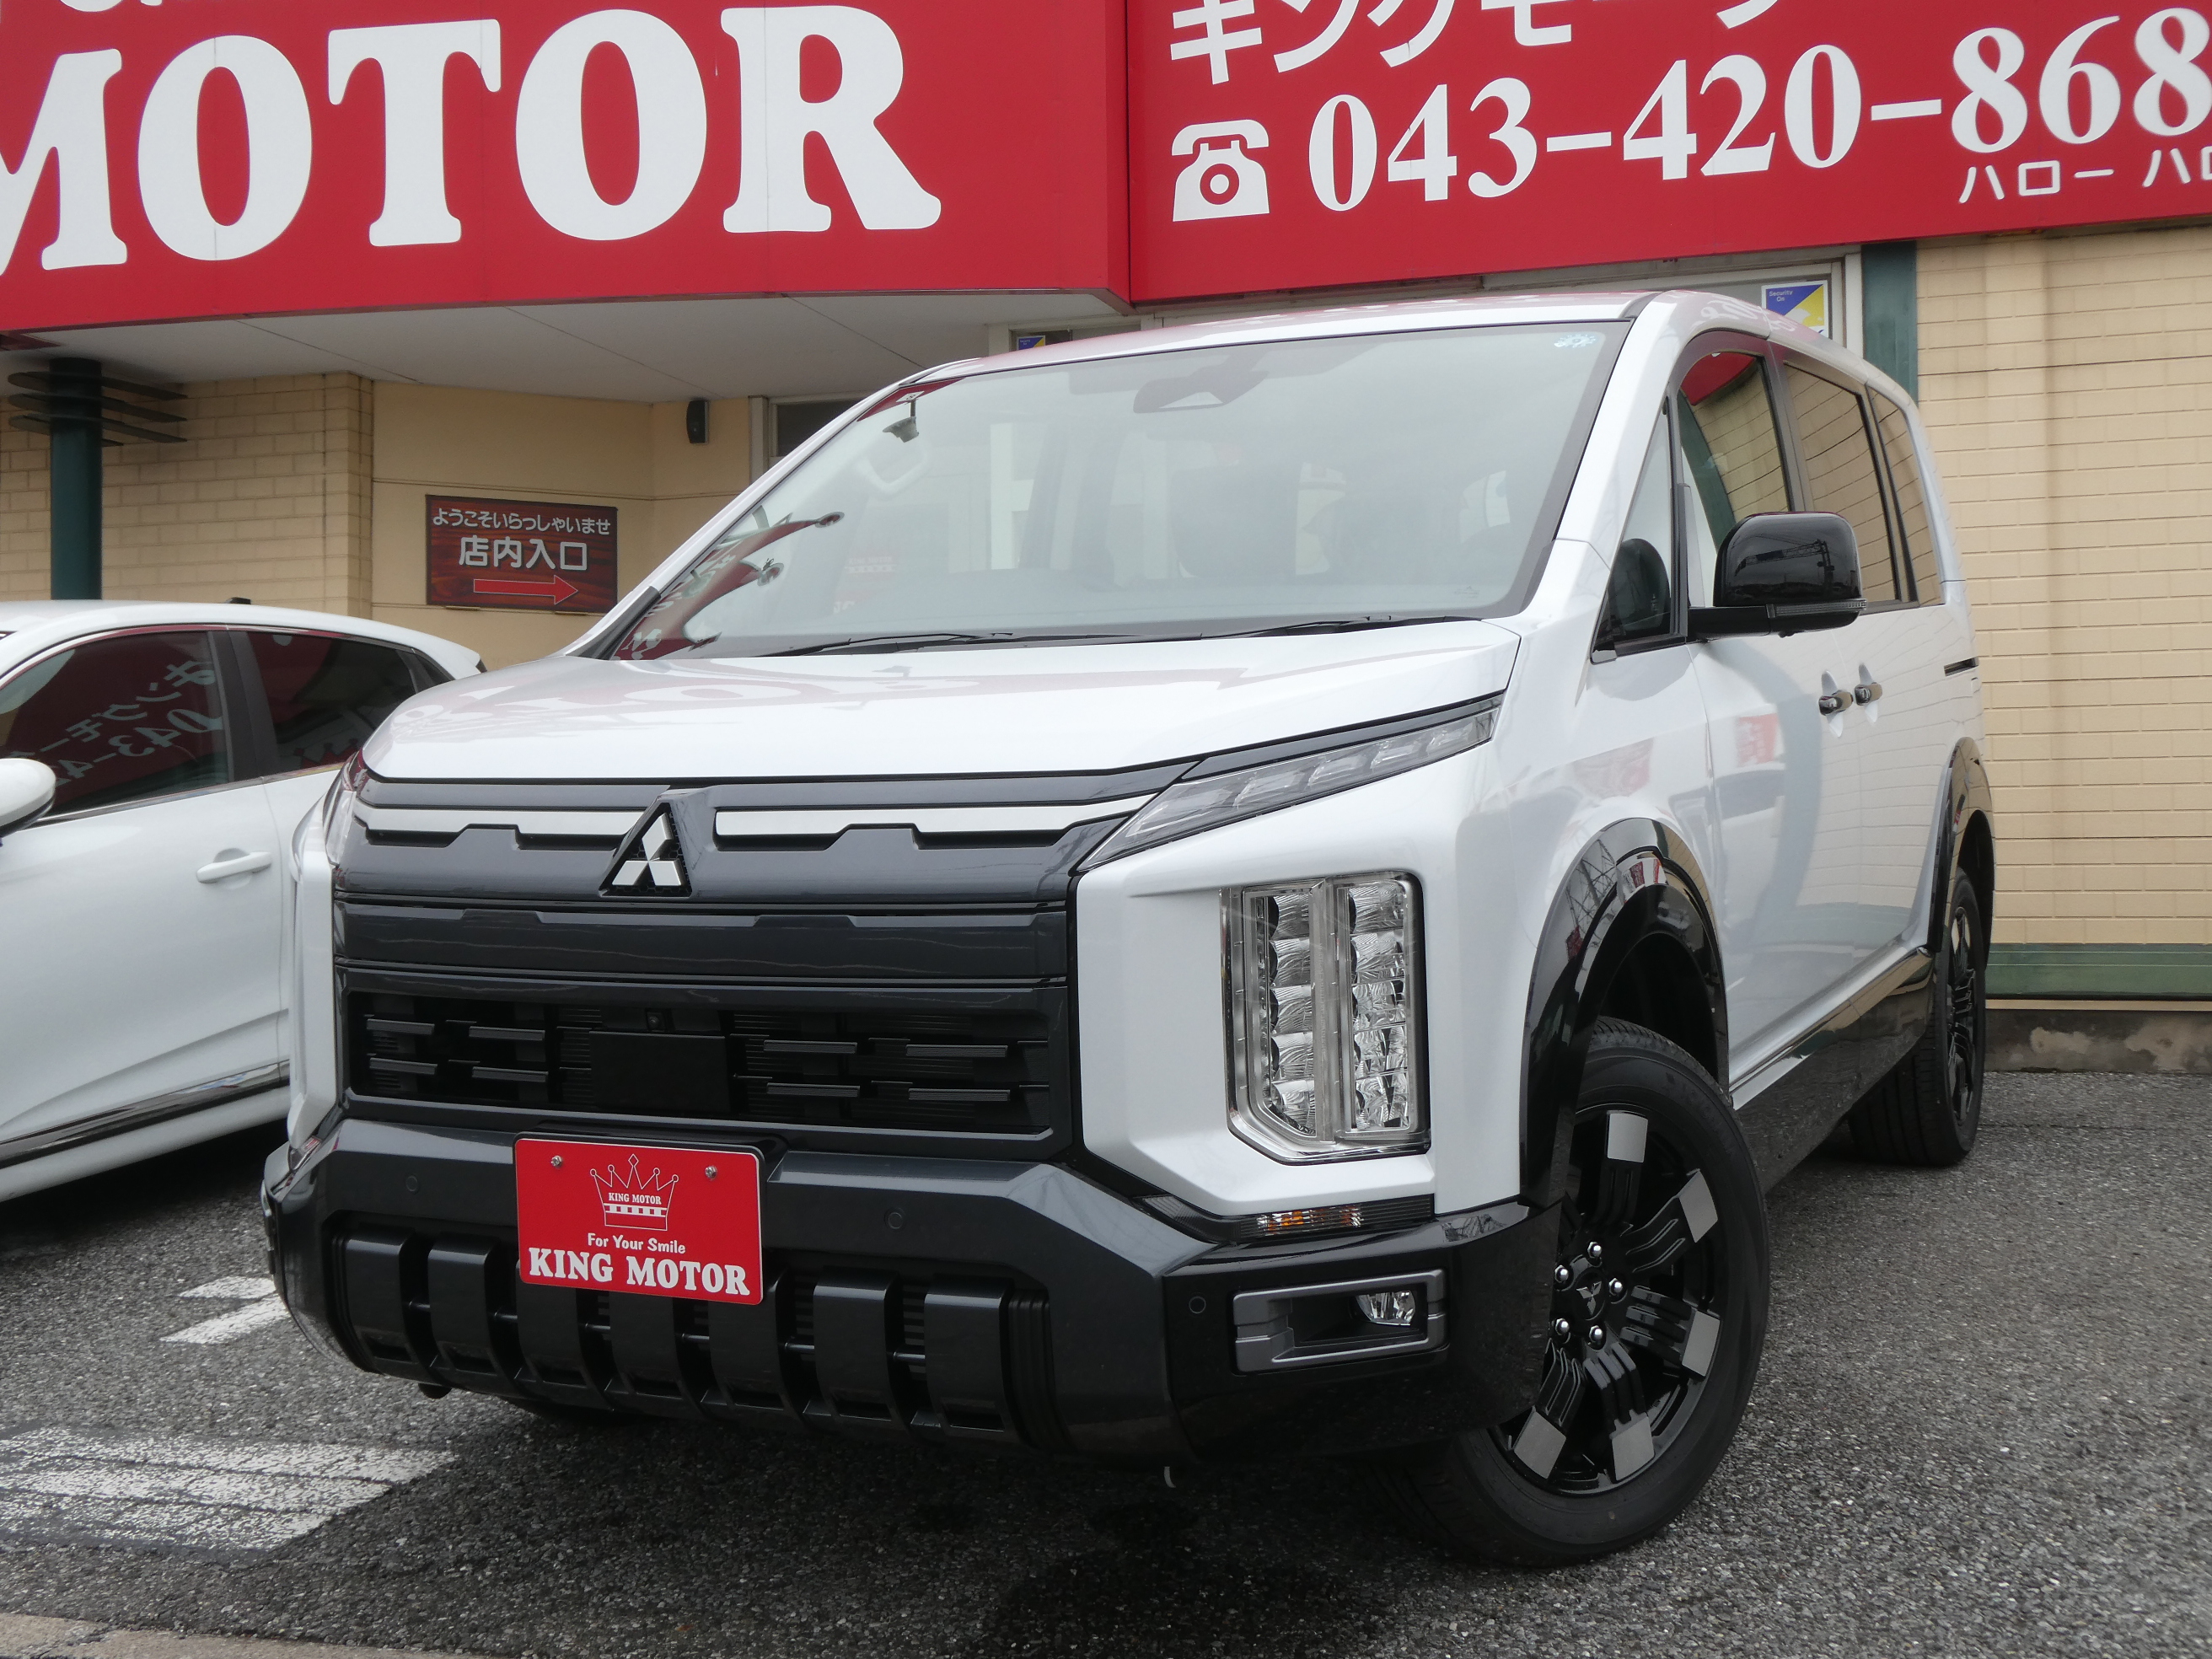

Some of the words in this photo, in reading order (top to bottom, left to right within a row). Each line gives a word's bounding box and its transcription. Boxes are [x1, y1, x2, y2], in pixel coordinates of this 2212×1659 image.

[0, 5, 942, 276] MOTOR
[1958, 159, 2114, 204] ハロー
[2142, 145, 2212, 188] ハ
[459, 534, 588, 571] 店内入口
[608, 1192, 630, 1203] KING
[632, 1194, 662, 1205] MOTOR
[588, 1232, 609, 1247] For
[613, 1234, 643, 1251] Your
[647, 1238, 686, 1254] Smile
[529, 1247, 613, 1283] KING
[626, 1255, 750, 1296] MOTOR
